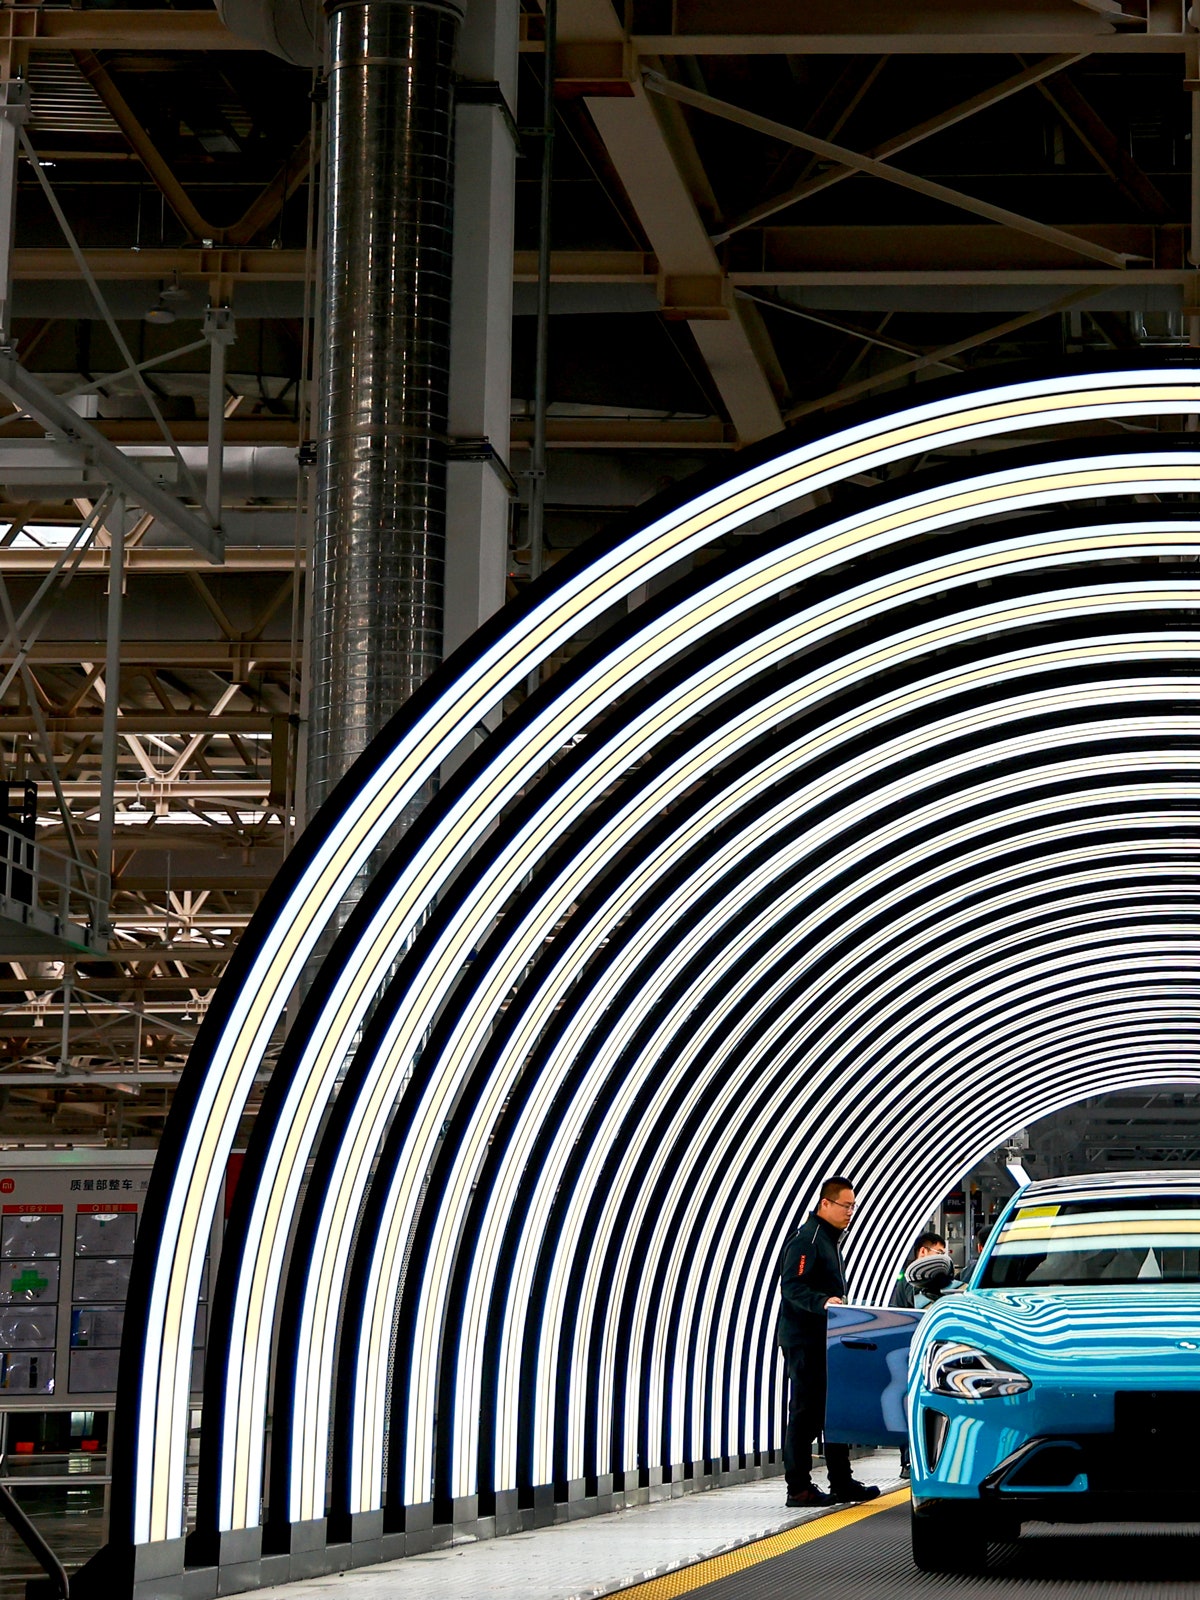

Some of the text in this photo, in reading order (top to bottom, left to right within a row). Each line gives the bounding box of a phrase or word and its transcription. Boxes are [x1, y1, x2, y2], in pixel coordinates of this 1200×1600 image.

[70, 1179, 133, 1191] 质量部整车
